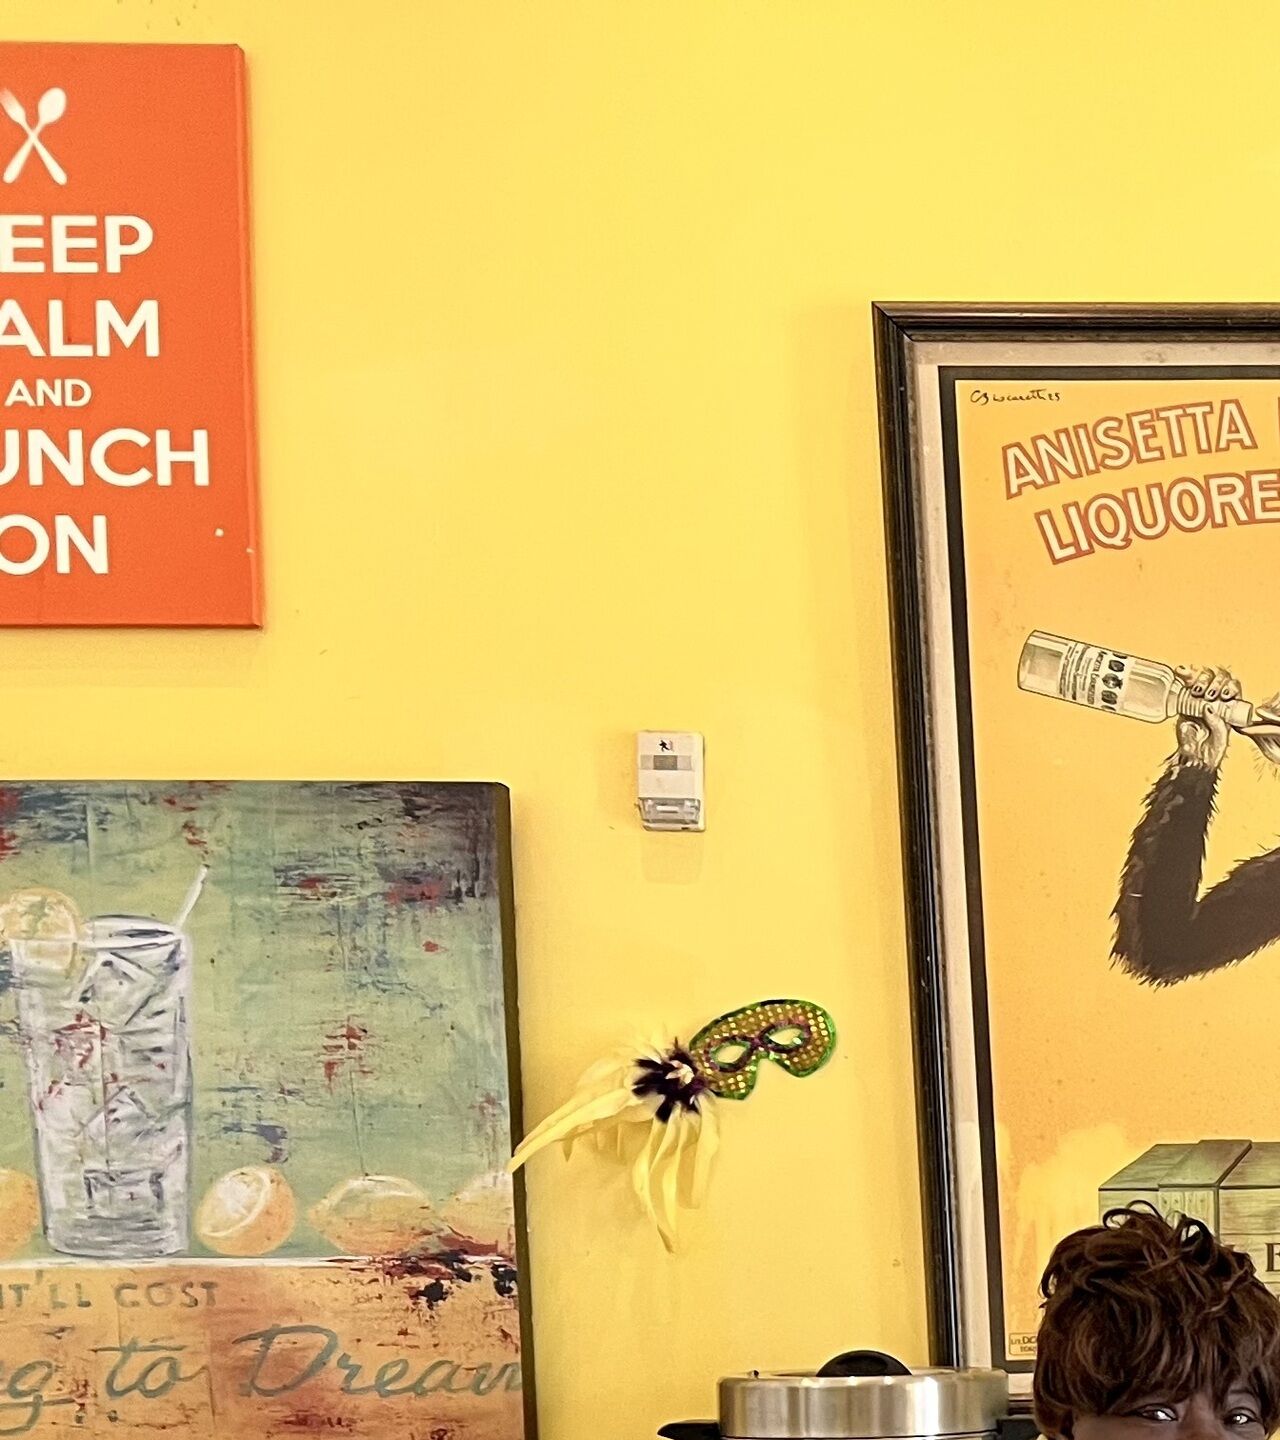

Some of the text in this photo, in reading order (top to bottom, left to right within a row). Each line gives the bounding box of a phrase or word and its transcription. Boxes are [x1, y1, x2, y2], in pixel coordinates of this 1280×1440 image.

[5, 378, 91, 407] AND
[1001, 398, 1258, 500] ANISETTA
[0, 514, 109, 576] ON
[113, 1280, 219, 1309] COST
[90, 1337, 208, 1399] to
